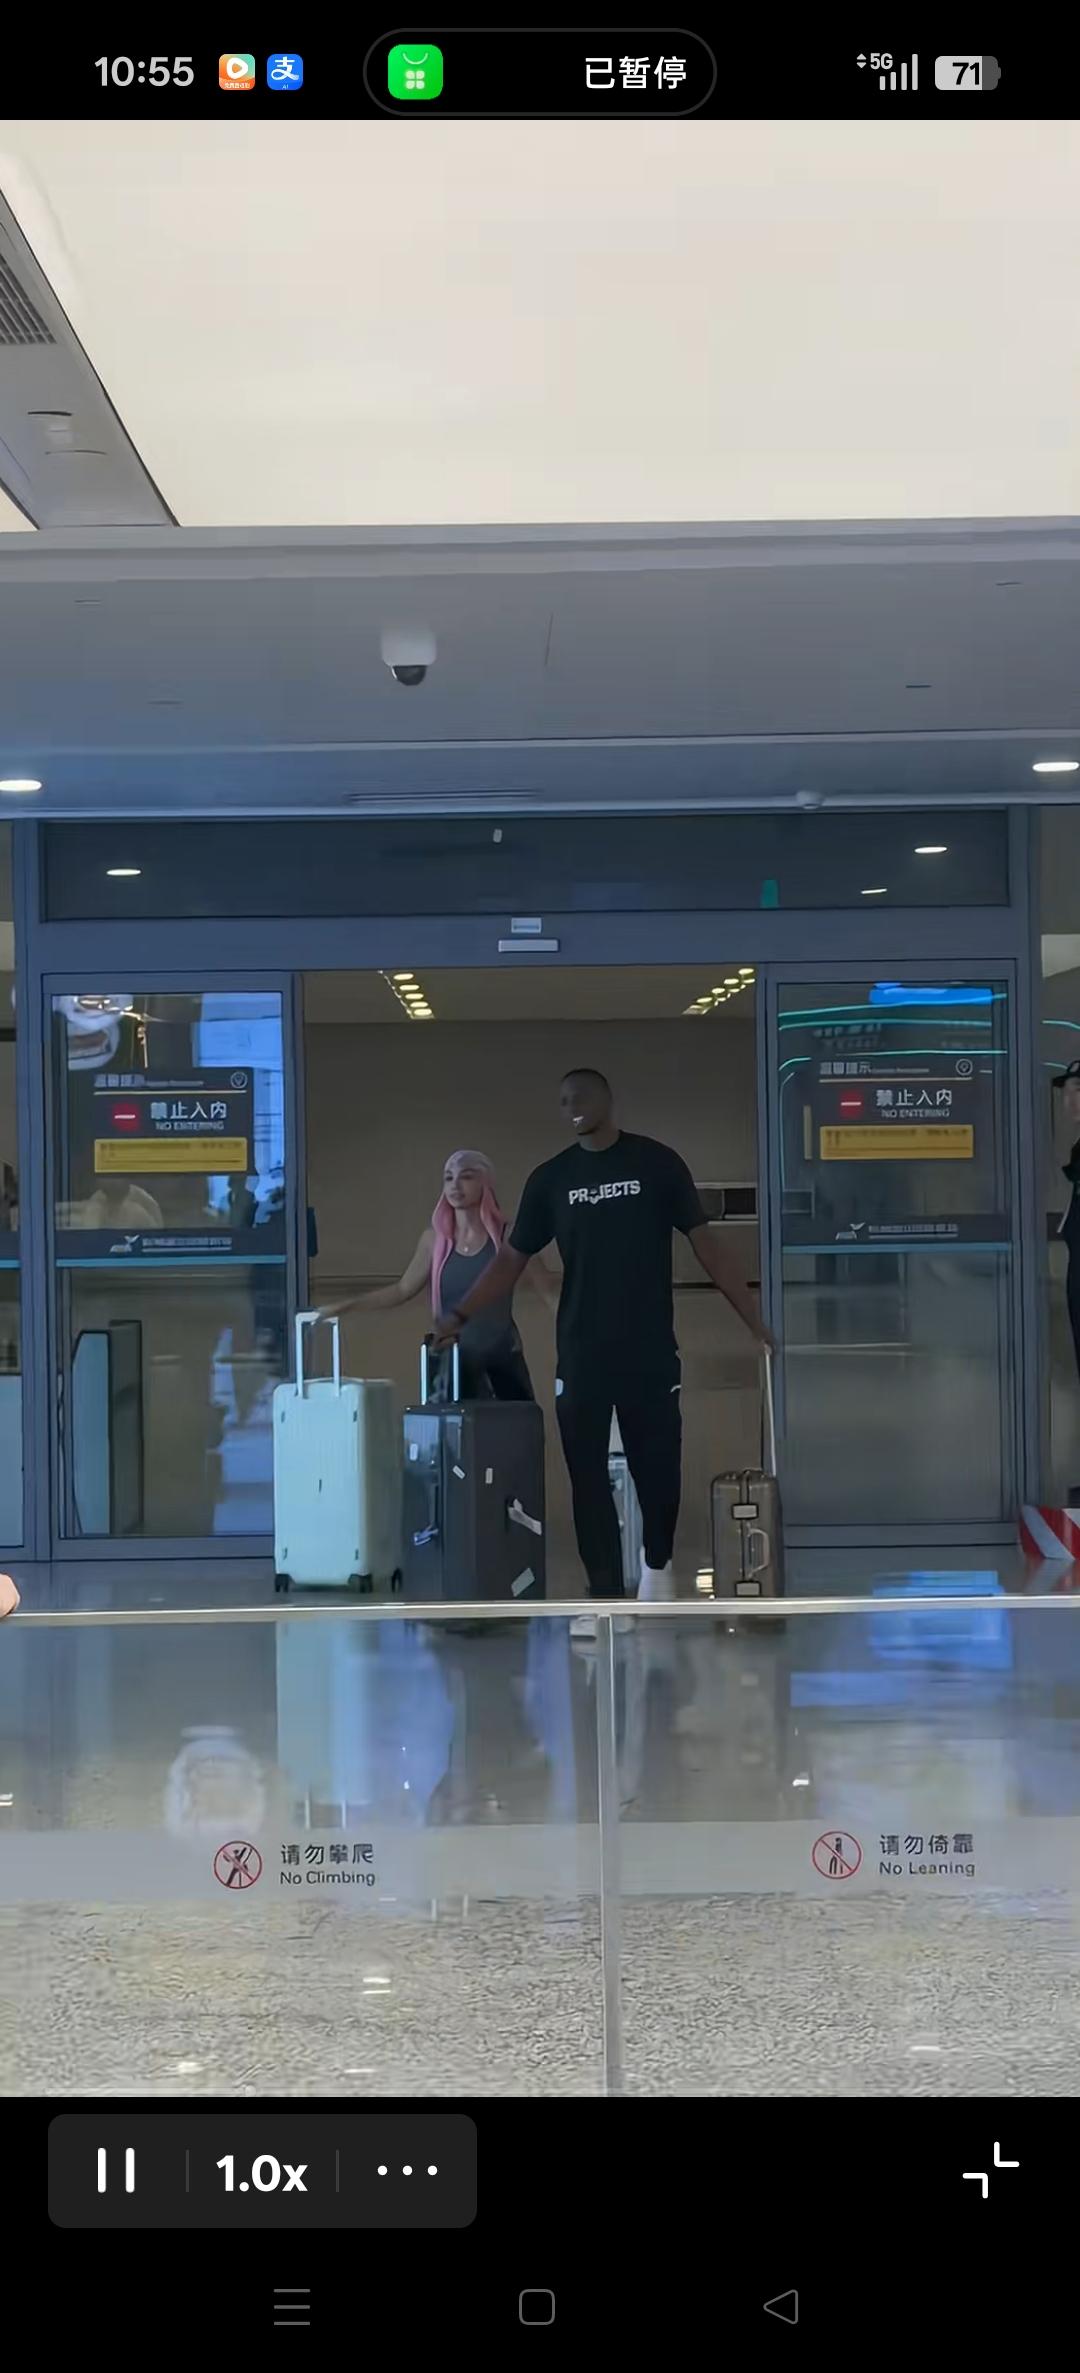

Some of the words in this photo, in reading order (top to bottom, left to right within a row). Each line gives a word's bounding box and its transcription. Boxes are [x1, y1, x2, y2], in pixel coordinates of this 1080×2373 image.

[876, 1088, 953, 1107] 禁止入内
[882, 1109, 898, 1119] NO
[156, 1121, 172, 1131] NO
[880, 1834, 974, 1855] 请勿倚靠
[281, 1844, 374, 1865] 请勿攀爬
[879, 1861, 903, 1876] No
[909, 1861, 976, 1877] Leaning
[280, 1871, 302, 1885] No
[306, 1870, 375, 1886] Climbing
